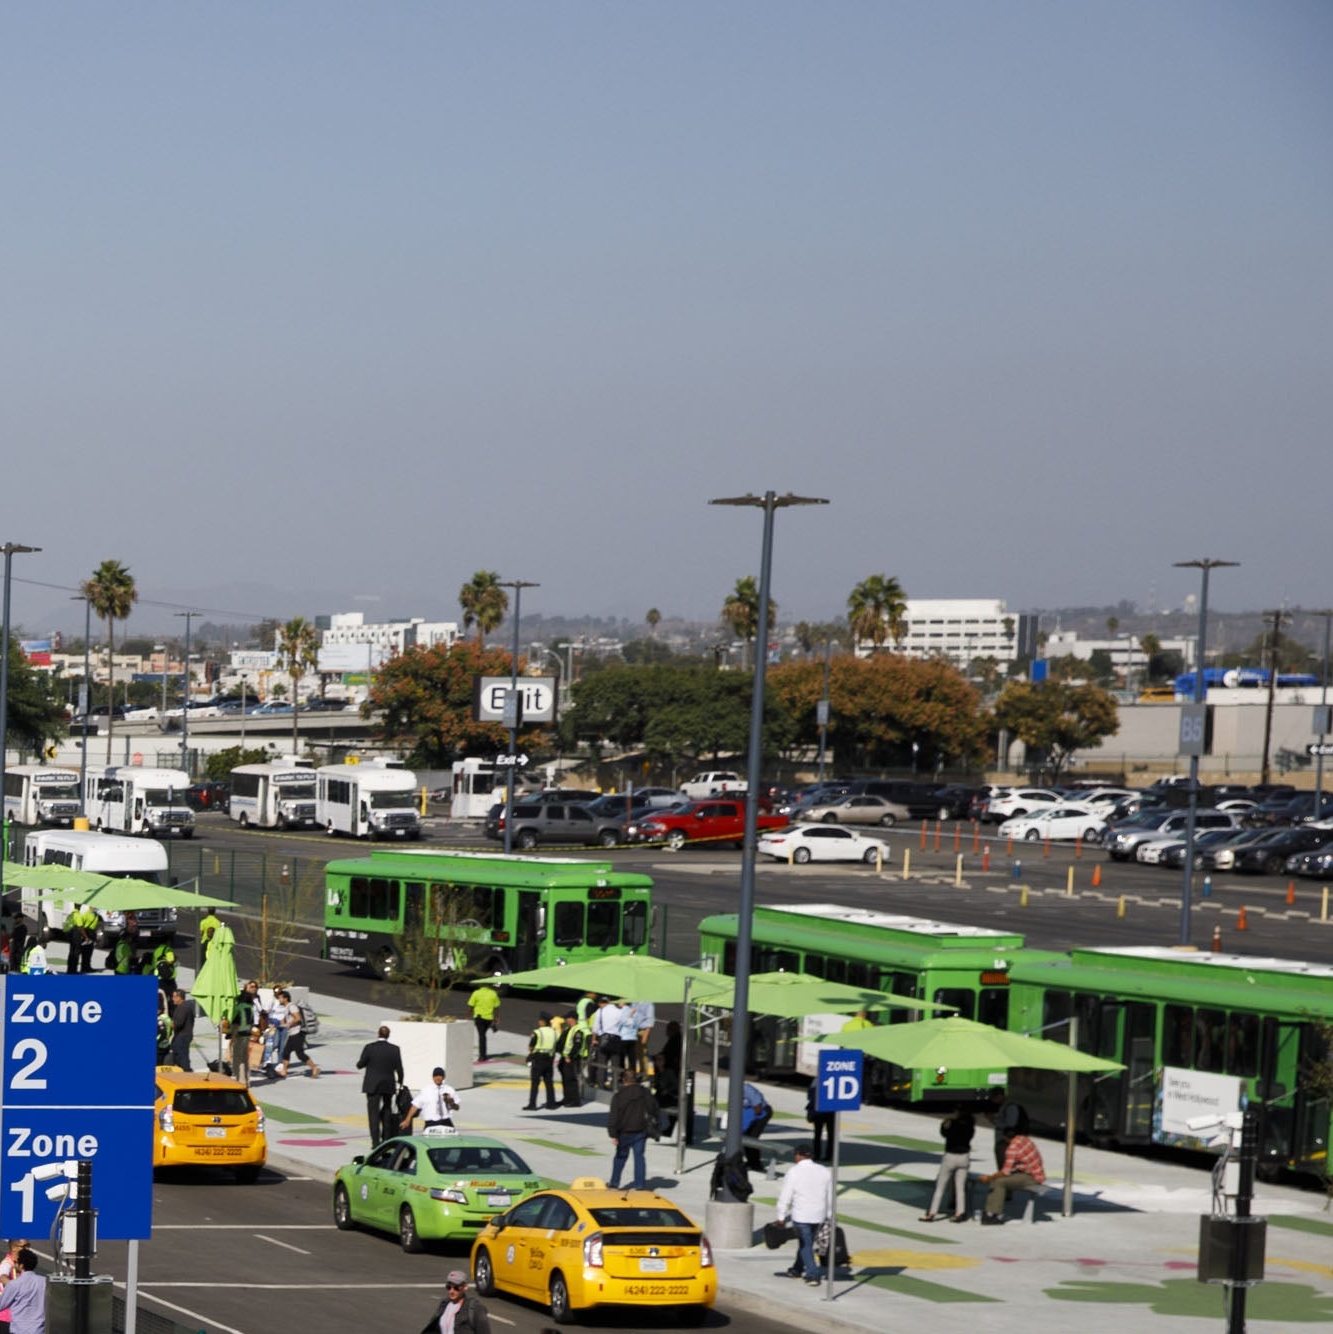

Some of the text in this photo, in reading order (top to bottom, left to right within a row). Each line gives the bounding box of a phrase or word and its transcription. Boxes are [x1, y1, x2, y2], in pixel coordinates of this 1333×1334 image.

[491, 687, 543, 711] Eit
[496, 754, 517, 765] Exit
[11, 993, 102, 1023] Zone
[10, 1038, 48, 1090] 2
[826, 1061, 856, 1072] ZONE
[822, 1076, 860, 1101] 1D
[7, 1128, 98, 1157] Zone
[10, 1172, 34, 1223] 1
[624, 1285, 689, 1296] (424) 222-2222
